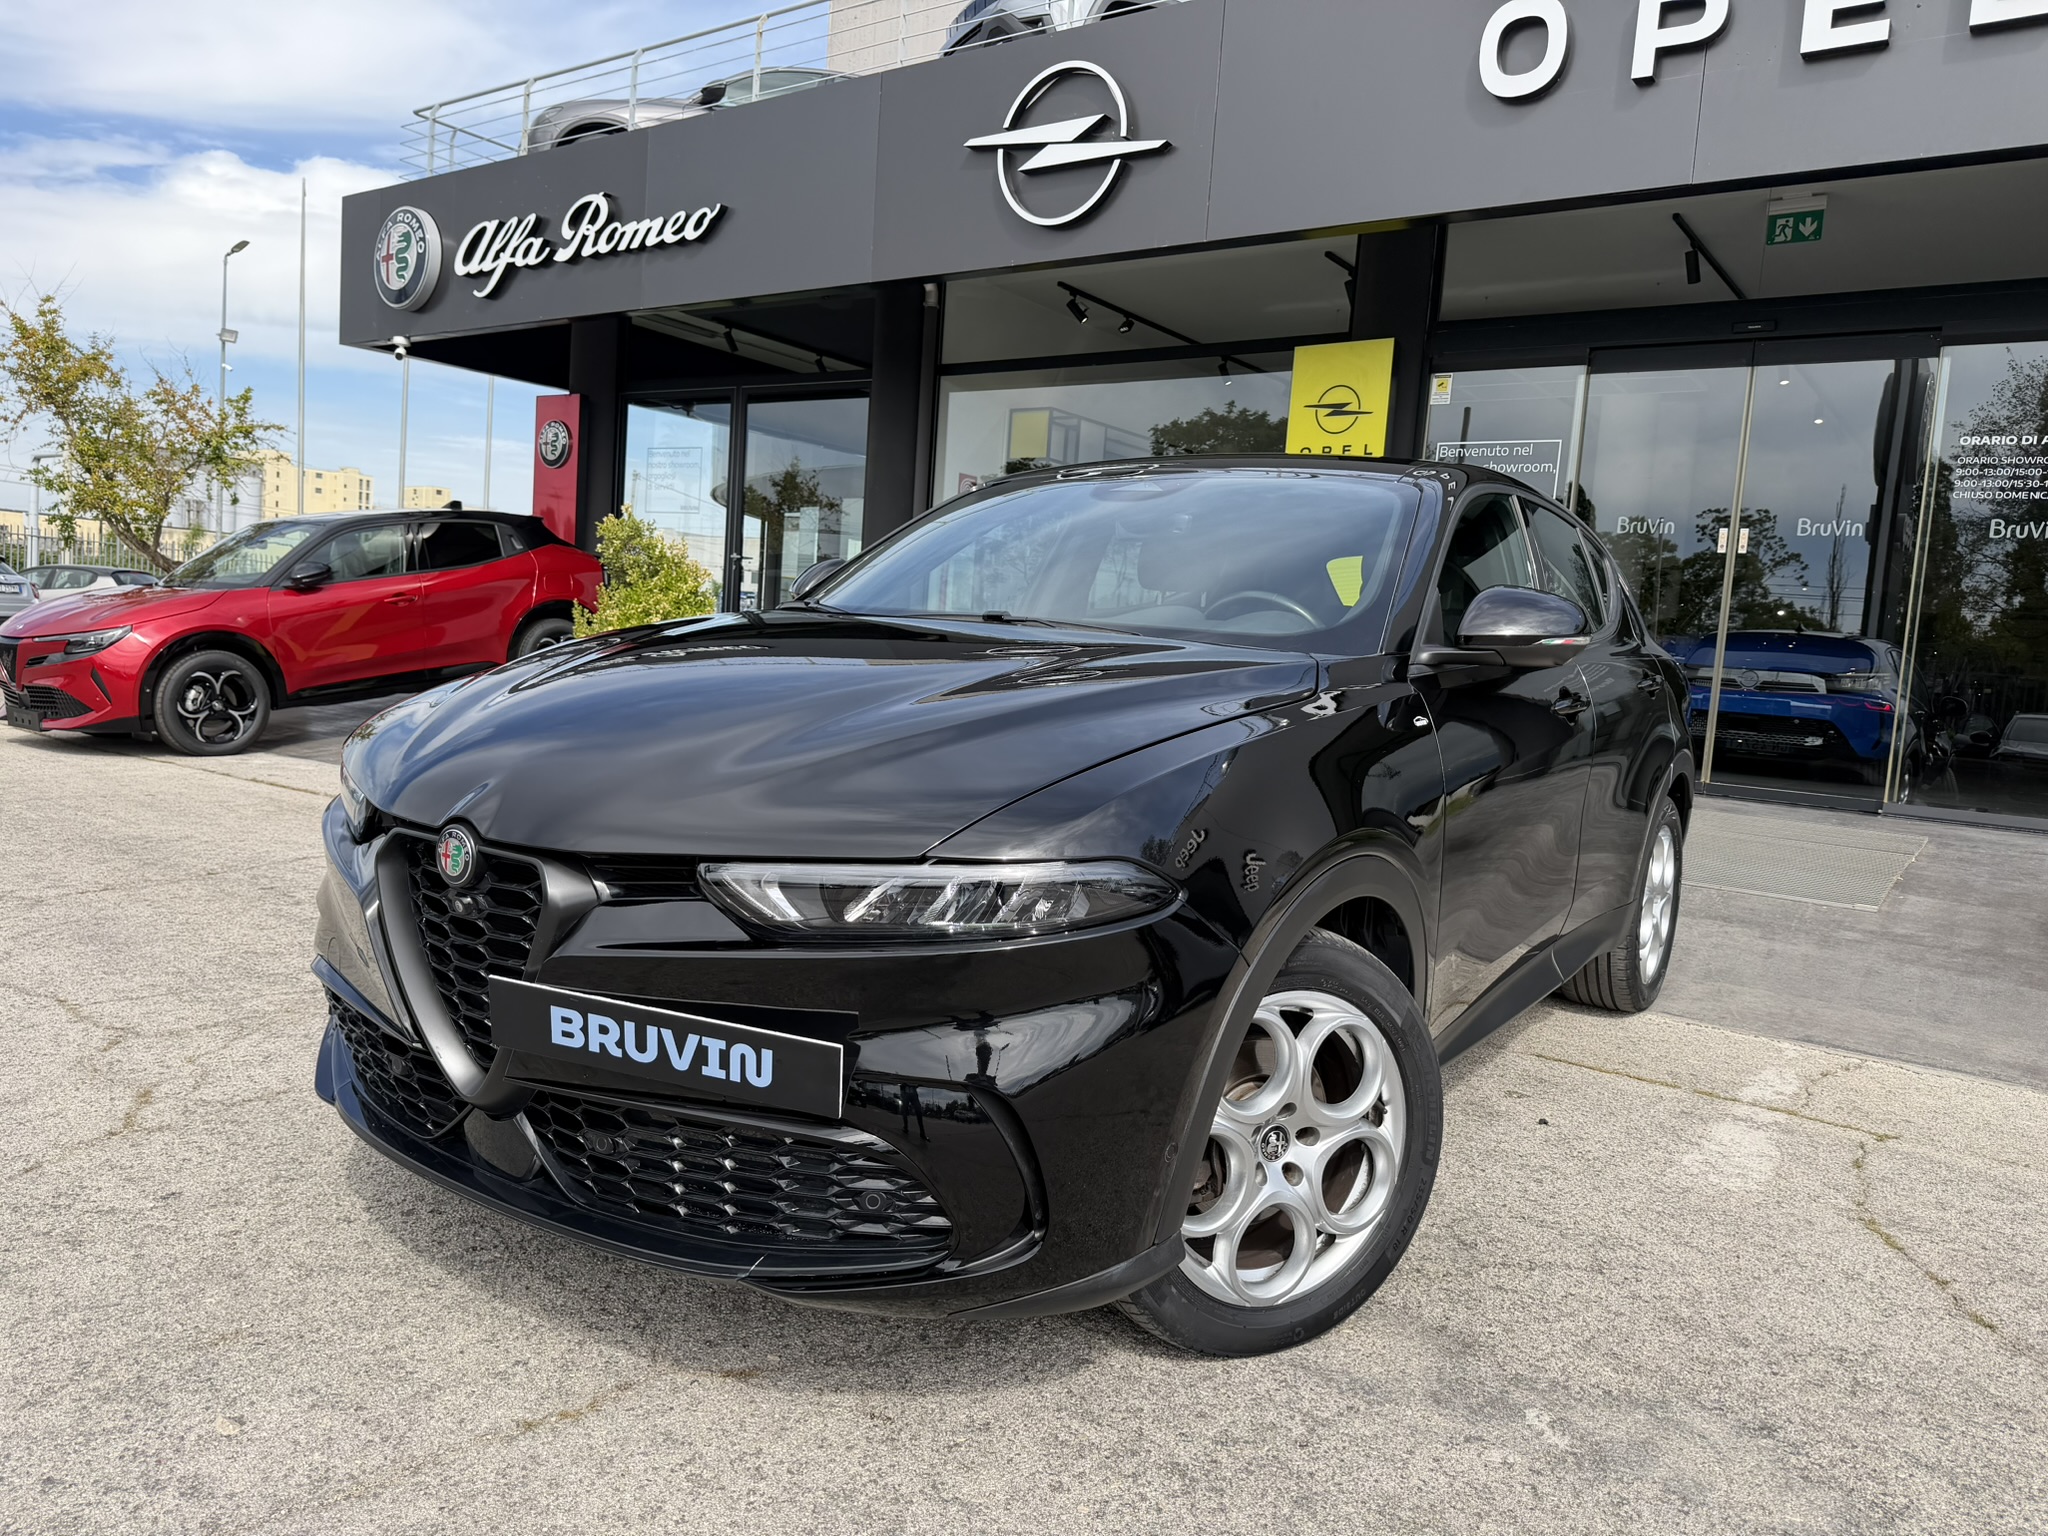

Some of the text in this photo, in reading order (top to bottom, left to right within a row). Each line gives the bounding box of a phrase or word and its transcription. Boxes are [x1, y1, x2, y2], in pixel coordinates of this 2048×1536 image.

[1479, 0, 2048, 100] OPE
[396, 212, 425, 253] ROMEO
[454, 191, 722, 299] Alfa Romeo
[1439, 443, 1534, 458] Benvenuto nel
[1959, 435, 2018, 446] ORARIO
[2021, 435, 2038, 445] DI
[1957, 456, 1999, 465] ORARIO
[1952, 490, 2048, 500] CHIUSO DOMENIC
[1616, 516, 1675, 535] BruVin
[1796, 517, 1864, 537] BruVin
[451, 832, 470, 861] ROMEO
[550, 1005, 774, 1088] BRUVIN
